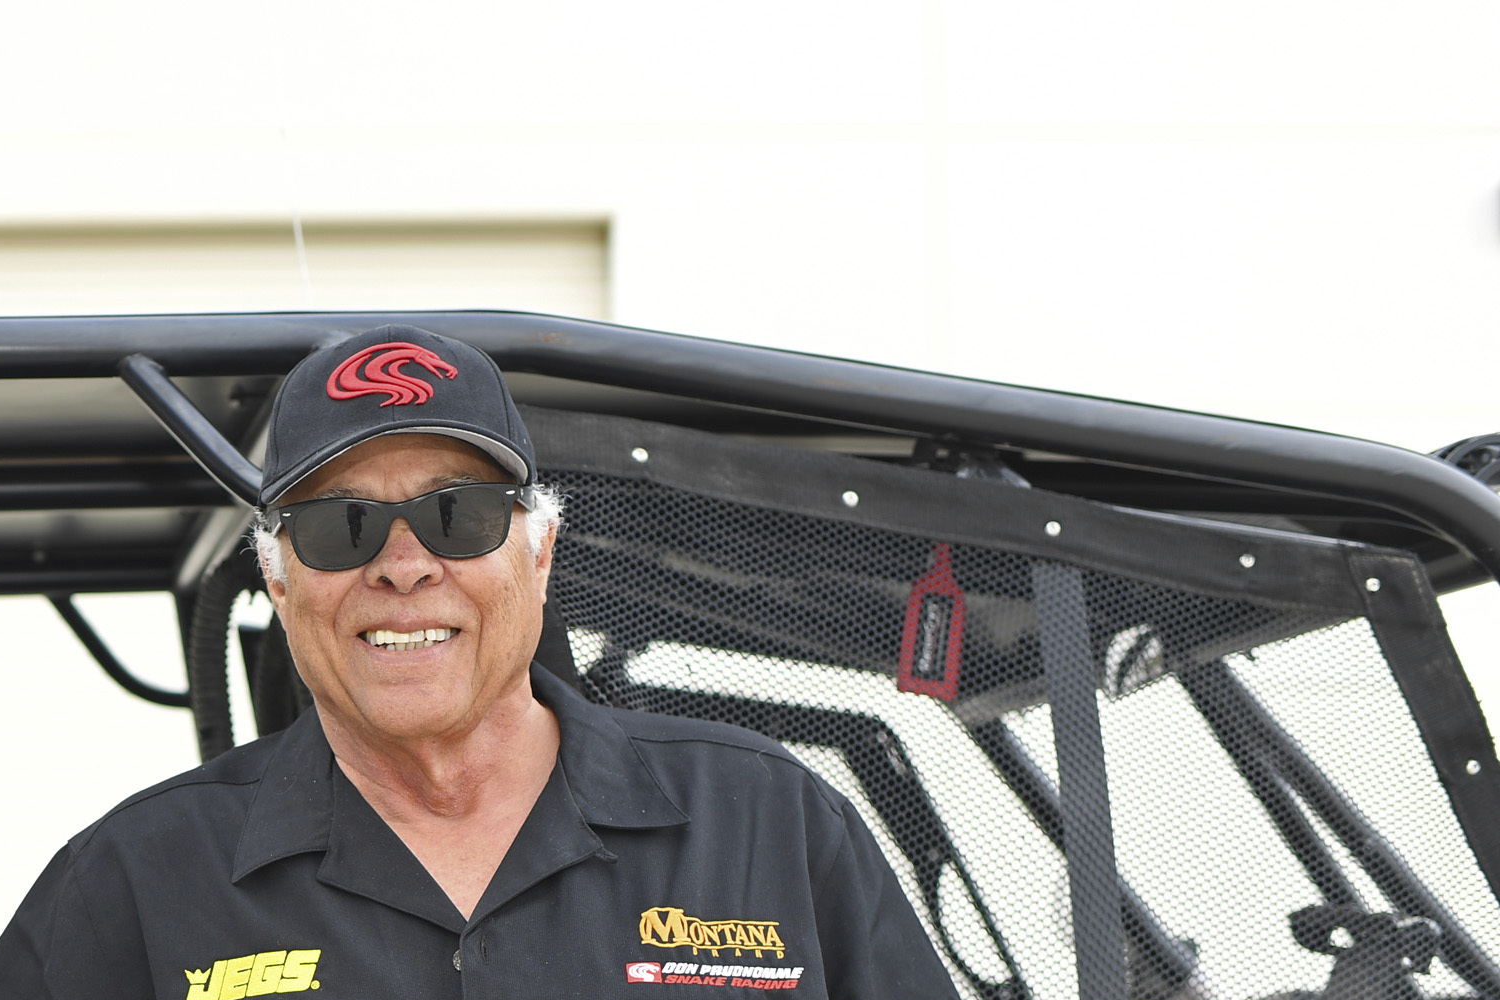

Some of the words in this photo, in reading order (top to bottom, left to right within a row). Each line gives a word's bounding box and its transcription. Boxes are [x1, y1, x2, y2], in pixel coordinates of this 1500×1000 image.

[639, 907, 785, 949] MONTANA
[661, 961, 699, 975] DON
[700, 964, 804, 980] PRUDHOMME
[664, 974, 727, 986] SNAKE
[730, 977, 799, 990] RACING
